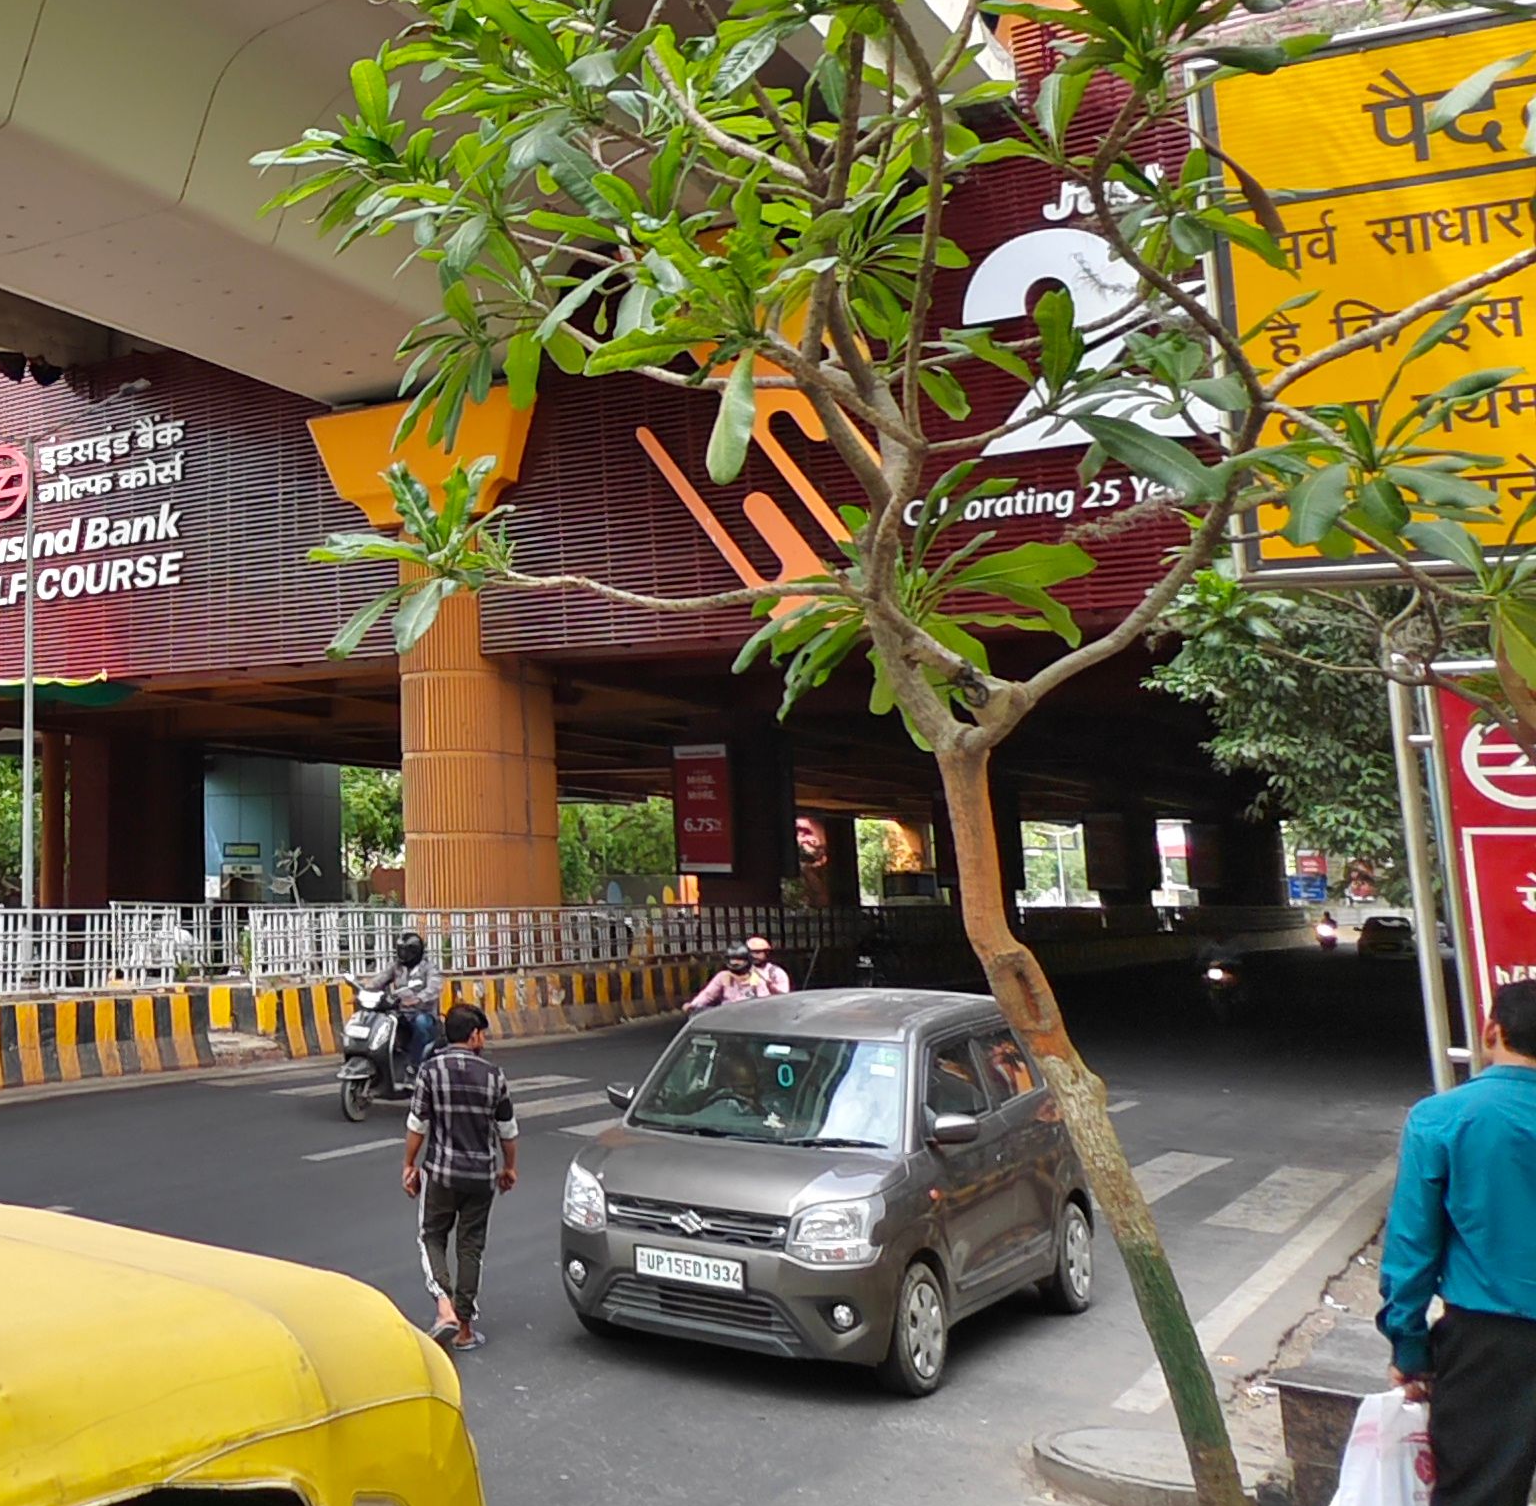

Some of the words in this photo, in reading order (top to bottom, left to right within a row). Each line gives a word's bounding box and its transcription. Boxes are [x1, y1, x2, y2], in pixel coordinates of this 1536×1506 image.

[1362, 69, 1536, 161] पैद
[1366, 198, 1534, 256] साधार
[135, 414, 186, 450] बैंक
[37, 473, 114, 503] गोल्फ
[117, 451, 185, 489] कोर्स
[1081, 475, 1121, 508] 25
[83, 502, 182, 552] Bank
[37, 551, 184, 601] COURSE
